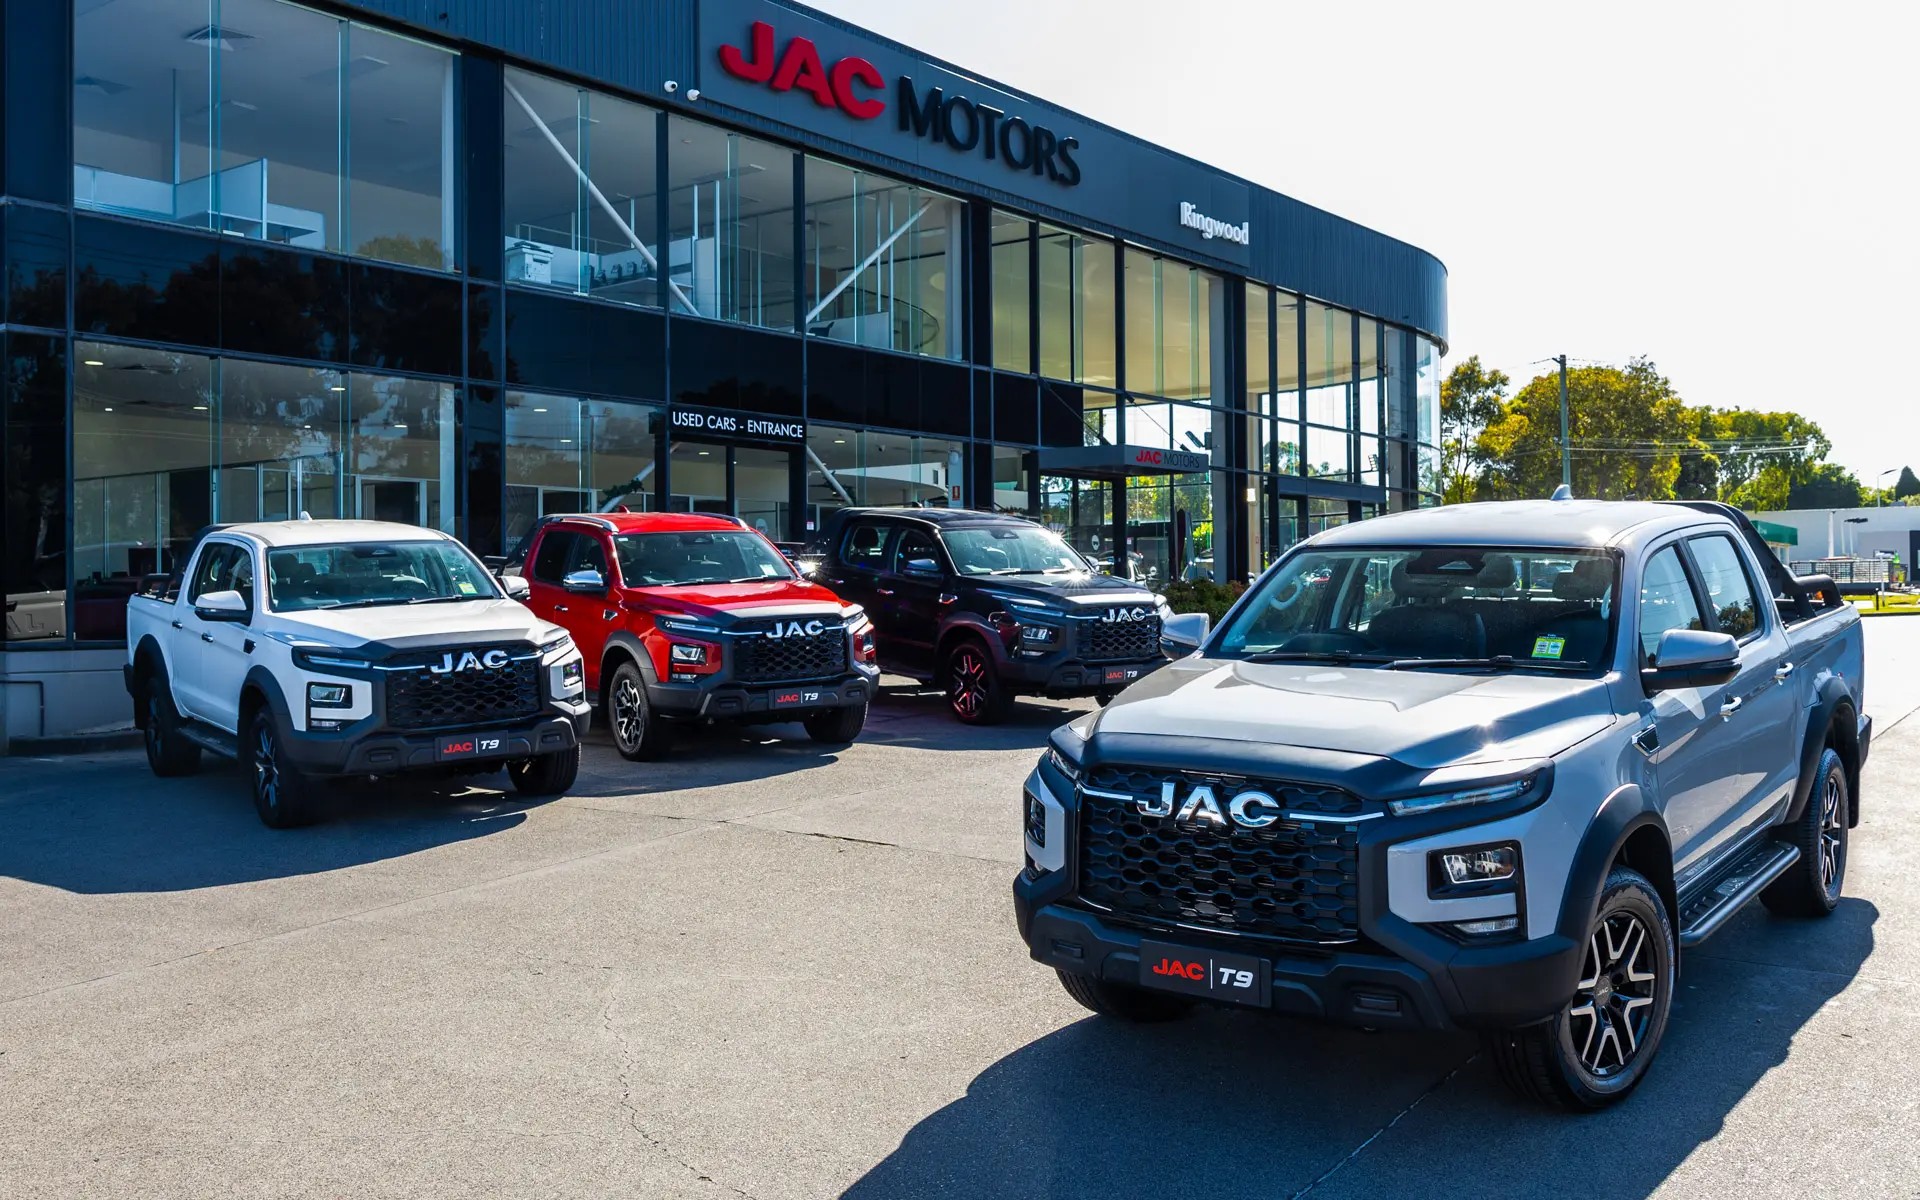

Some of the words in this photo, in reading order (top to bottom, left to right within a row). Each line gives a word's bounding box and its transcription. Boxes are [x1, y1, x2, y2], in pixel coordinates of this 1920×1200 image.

[718, 20, 886, 120] JAC
[898, 75, 1081, 186] MOTORS
[1180, 201, 1249, 245] Ringwood
[672, 411, 704, 427] USED
[707, 415, 736, 431] CARS
[747, 419, 803, 438] ENTRANCE
[1136, 450, 1162, 464] JAC
[1164, 452, 1199, 468] MOTORS
[1101, 607, 1146, 623] JAC
[766, 620, 824, 639] JAC
[430, 649, 509, 673] JAC
[777, 694, 799, 703] JAC
[804, 692, 819, 701] T9
[443, 741, 473, 754] JAC
[480, 739, 500, 750] T9
[1136, 781, 1280, 828] JAC
[1152, 958, 1205, 981] JAC
[1218, 967, 1254, 989] T9
